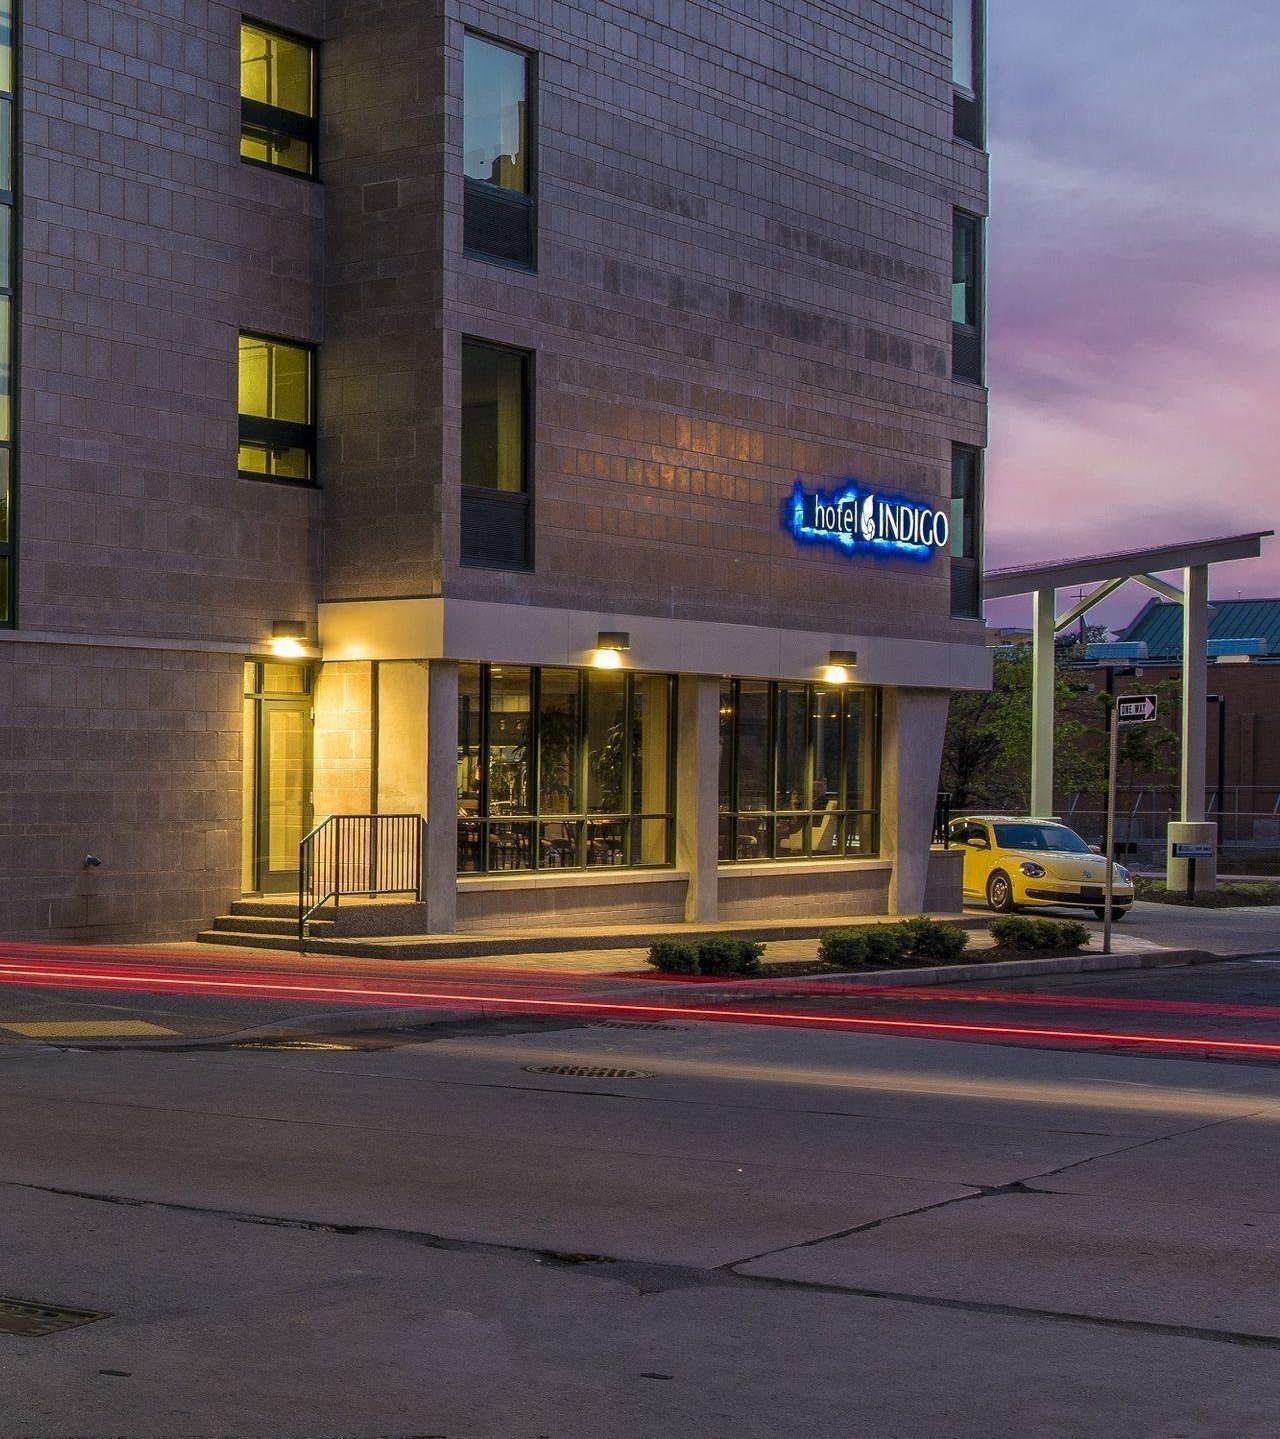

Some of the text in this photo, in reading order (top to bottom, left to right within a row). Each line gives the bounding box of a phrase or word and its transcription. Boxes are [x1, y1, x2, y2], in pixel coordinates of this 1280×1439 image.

[815, 494, 949, 547] hotel INDIGO
[1121, 704, 1132, 715] ONE
